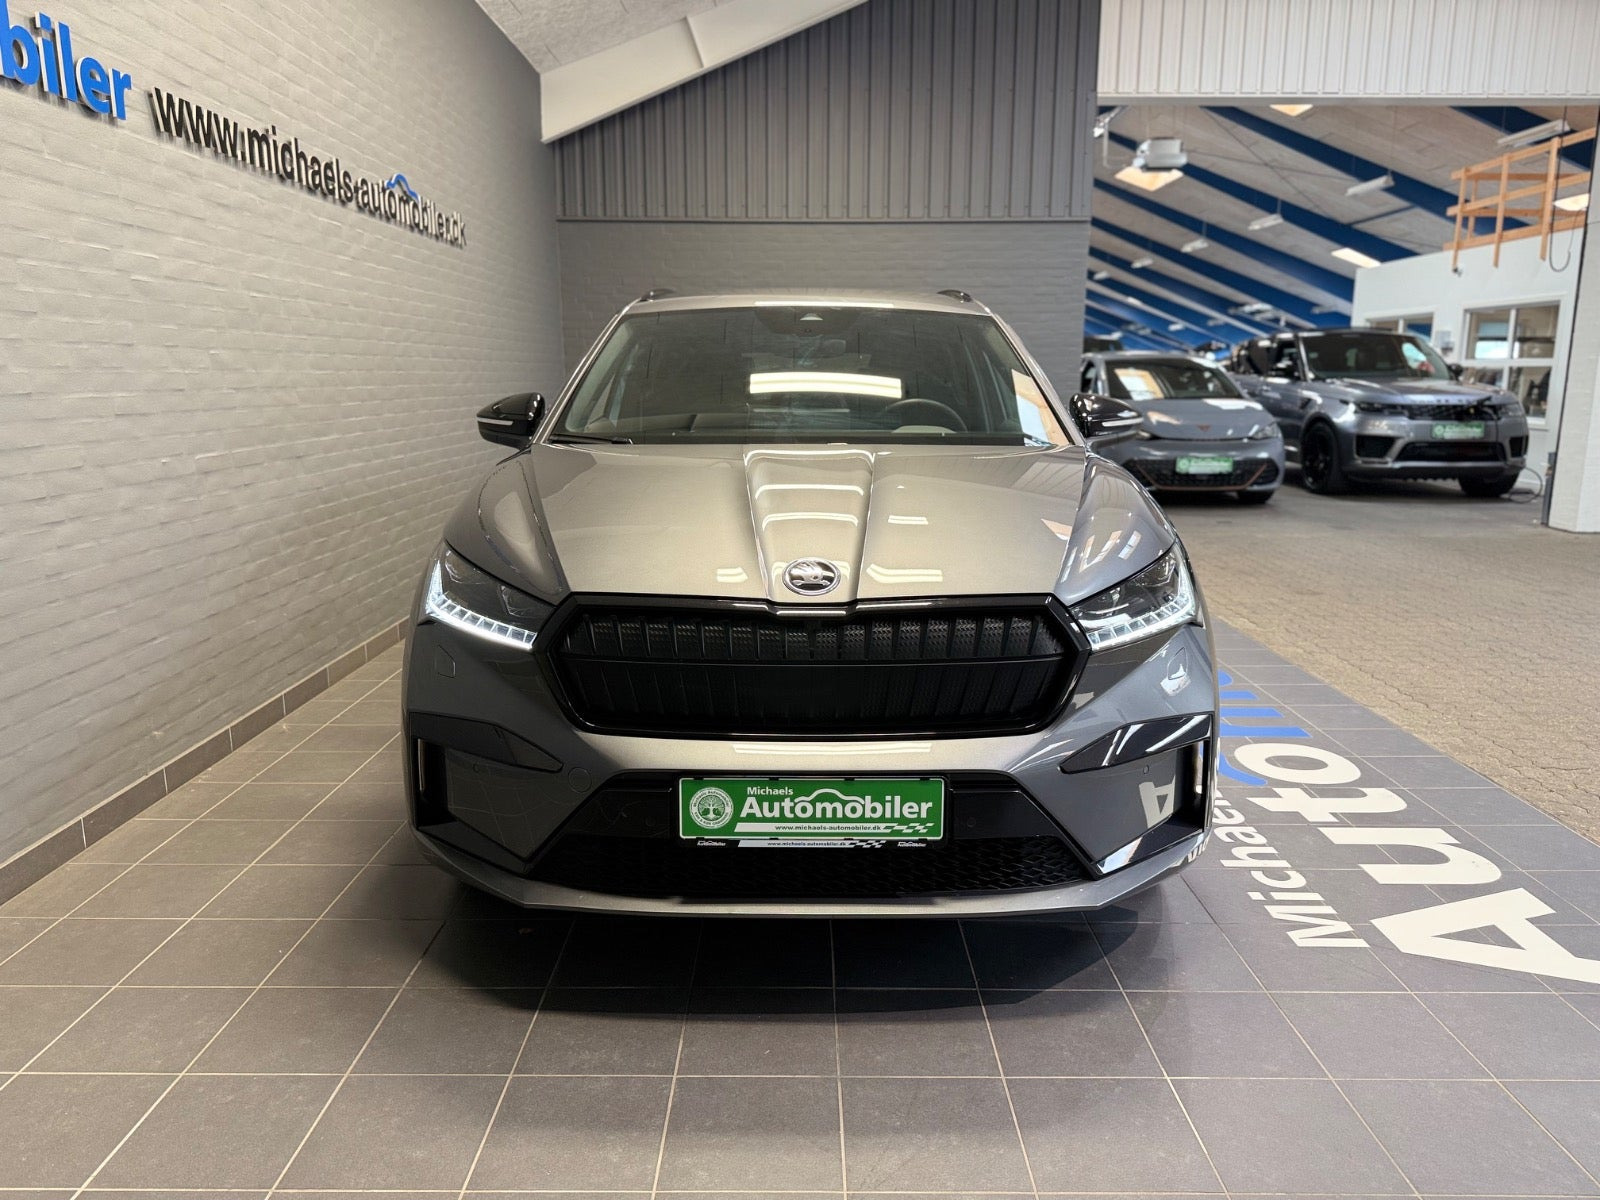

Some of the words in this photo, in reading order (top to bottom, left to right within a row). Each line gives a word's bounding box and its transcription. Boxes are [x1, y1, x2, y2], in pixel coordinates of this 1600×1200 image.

[149, 86, 467, 249] www.michaels-automobiler.dk
[746, 785, 794, 796] Michaels
[740, 795, 933, 819] Automobiler
